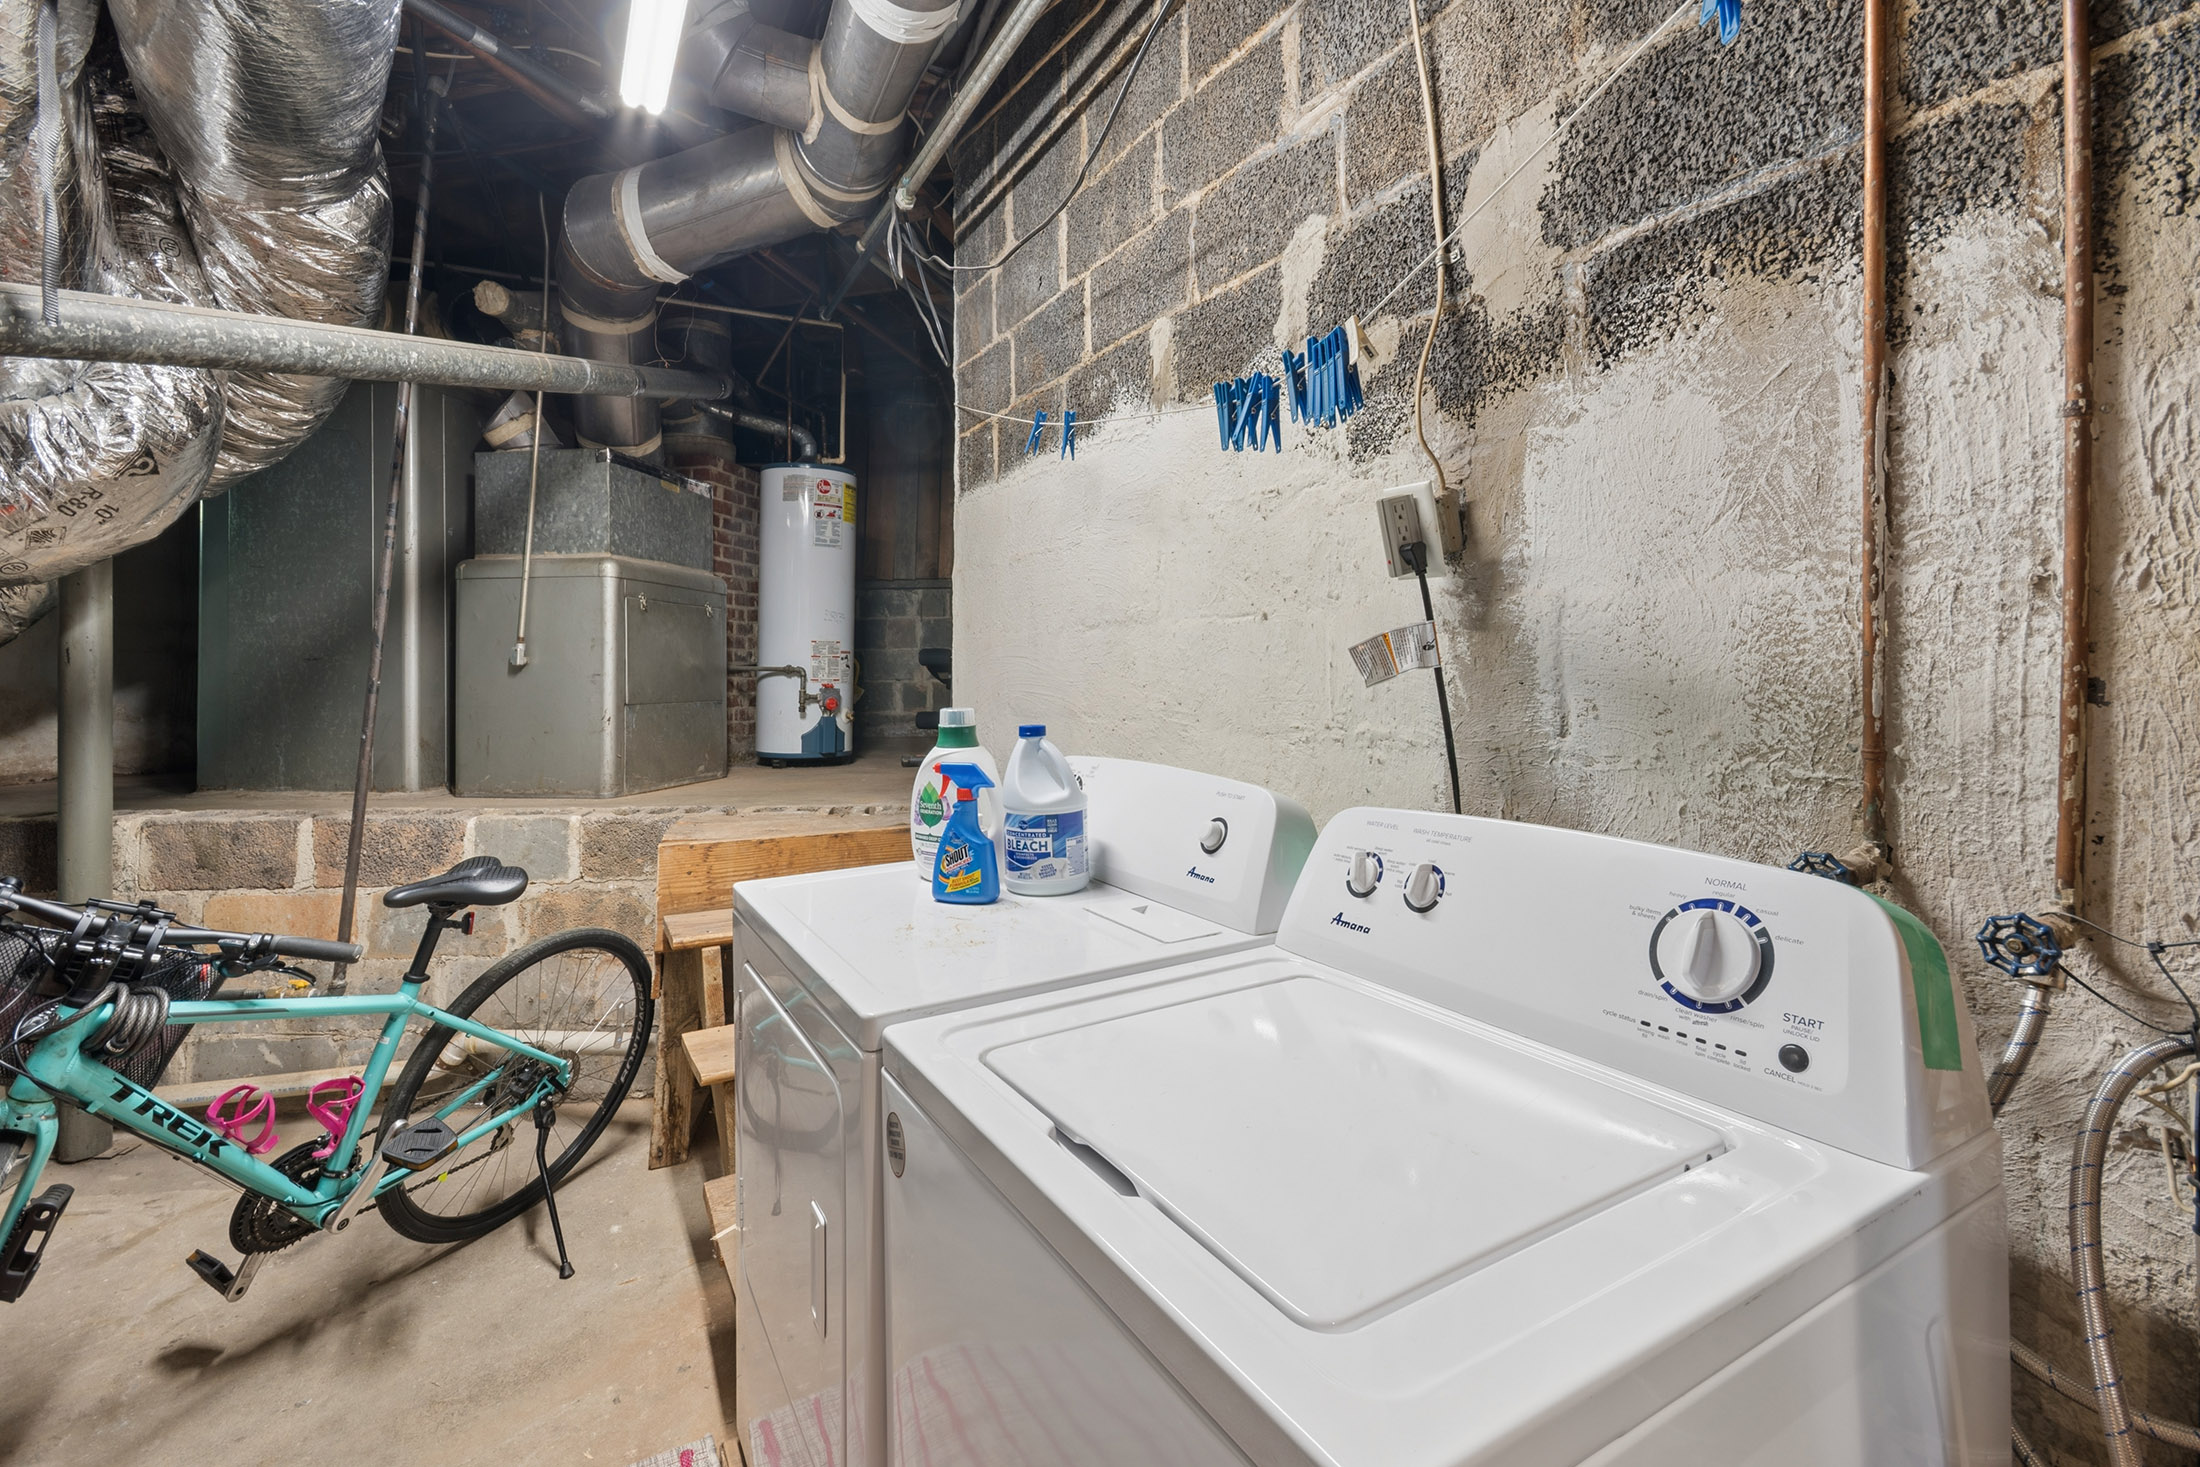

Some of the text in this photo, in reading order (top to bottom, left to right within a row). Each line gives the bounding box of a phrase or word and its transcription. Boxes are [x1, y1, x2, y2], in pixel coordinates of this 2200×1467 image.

[57, 487, 103, 517] R-8.0
[1366, 820, 1399, 831] WATER LEVEL
[1413, 828, 1473, 843] WASH TEMPERATURE
[1007, 839, 1048, 851] BLEACH
[945, 844, 969, 868] SHOUT
[1186, 866, 1215, 884] Amana
[1704, 877, 1747, 891] NORMAL
[1712, 890, 1736, 899] regular
[1629, 904, 1662, 916] bulky items
[1637, 911, 1656, 921] sheets
[1755, 908, 1779, 917] casual
[1330, 912, 1371, 934] Amana
[1775, 935, 1804, 945] delicate
[1637, 989, 1669, 1003] drain/spin
[1602, 1008, 1636, 1023] cycle status
[1675, 1007, 1718, 1023] clean washer
[1730, 1014, 1765, 1029] rinse/spin
[1782, 1012, 1825, 1030] START
[621, 982, 645, 1083] BONTRAGER
[1782, 1028, 1808, 1040] UNLOCK
[1791, 1025, 1814, 1034] PAUSE/
[1712, 1051, 1726, 1059] cycle
[1763, 1067, 1796, 1083] CANCEL
[110, 1077, 231, 1158] TREK
